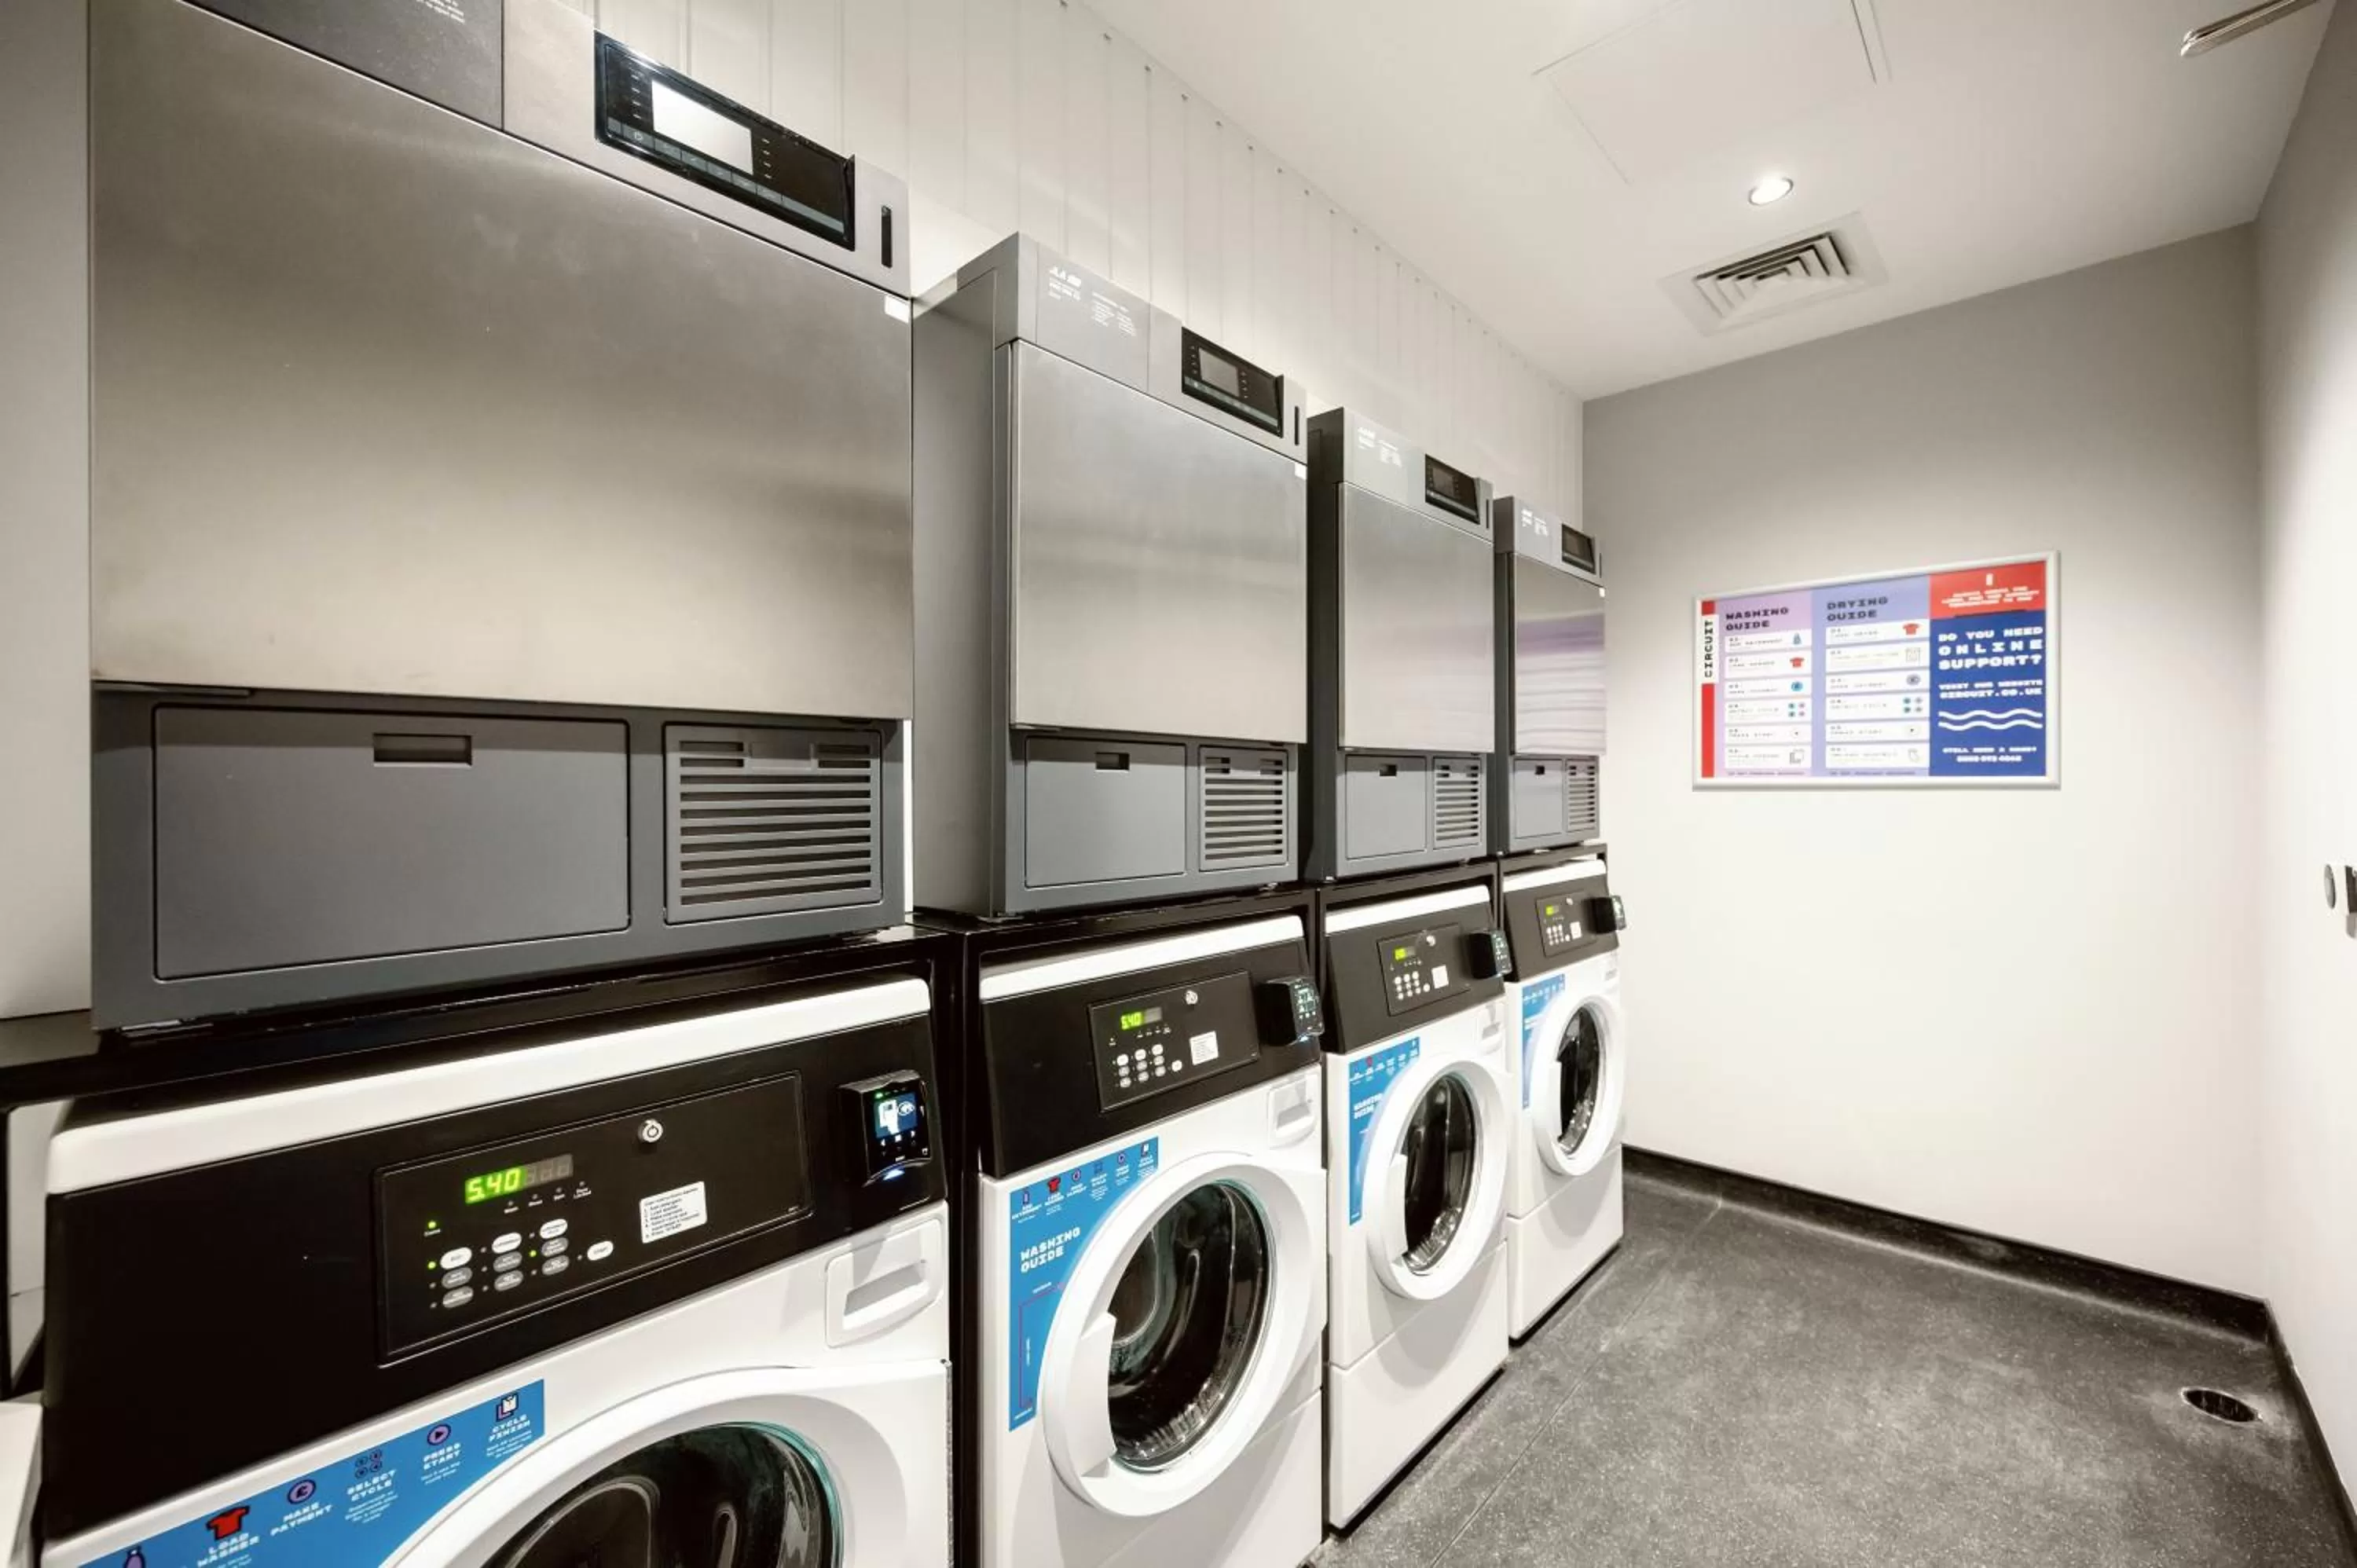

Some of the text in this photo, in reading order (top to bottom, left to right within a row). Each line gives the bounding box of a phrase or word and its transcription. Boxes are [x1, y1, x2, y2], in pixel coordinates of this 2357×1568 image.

[1827, 596, 1888, 610] DRYING
[1725, 606, 1789, 620] WASHING
[1827, 610, 1877, 621] GUIDE
[1725, 620, 1770, 631] GUIDE
[1938, 627, 2043, 642] DO YOU NEED
[1704, 620, 1714, 678] CIRCUIT
[1938, 639, 2043, 656] ONLINE
[1938, 654, 2042, 670] SUPPORT?
[1021, 1226, 1080, 1262] WASHING
[1021, 1245, 1065, 1273] GUIDE
